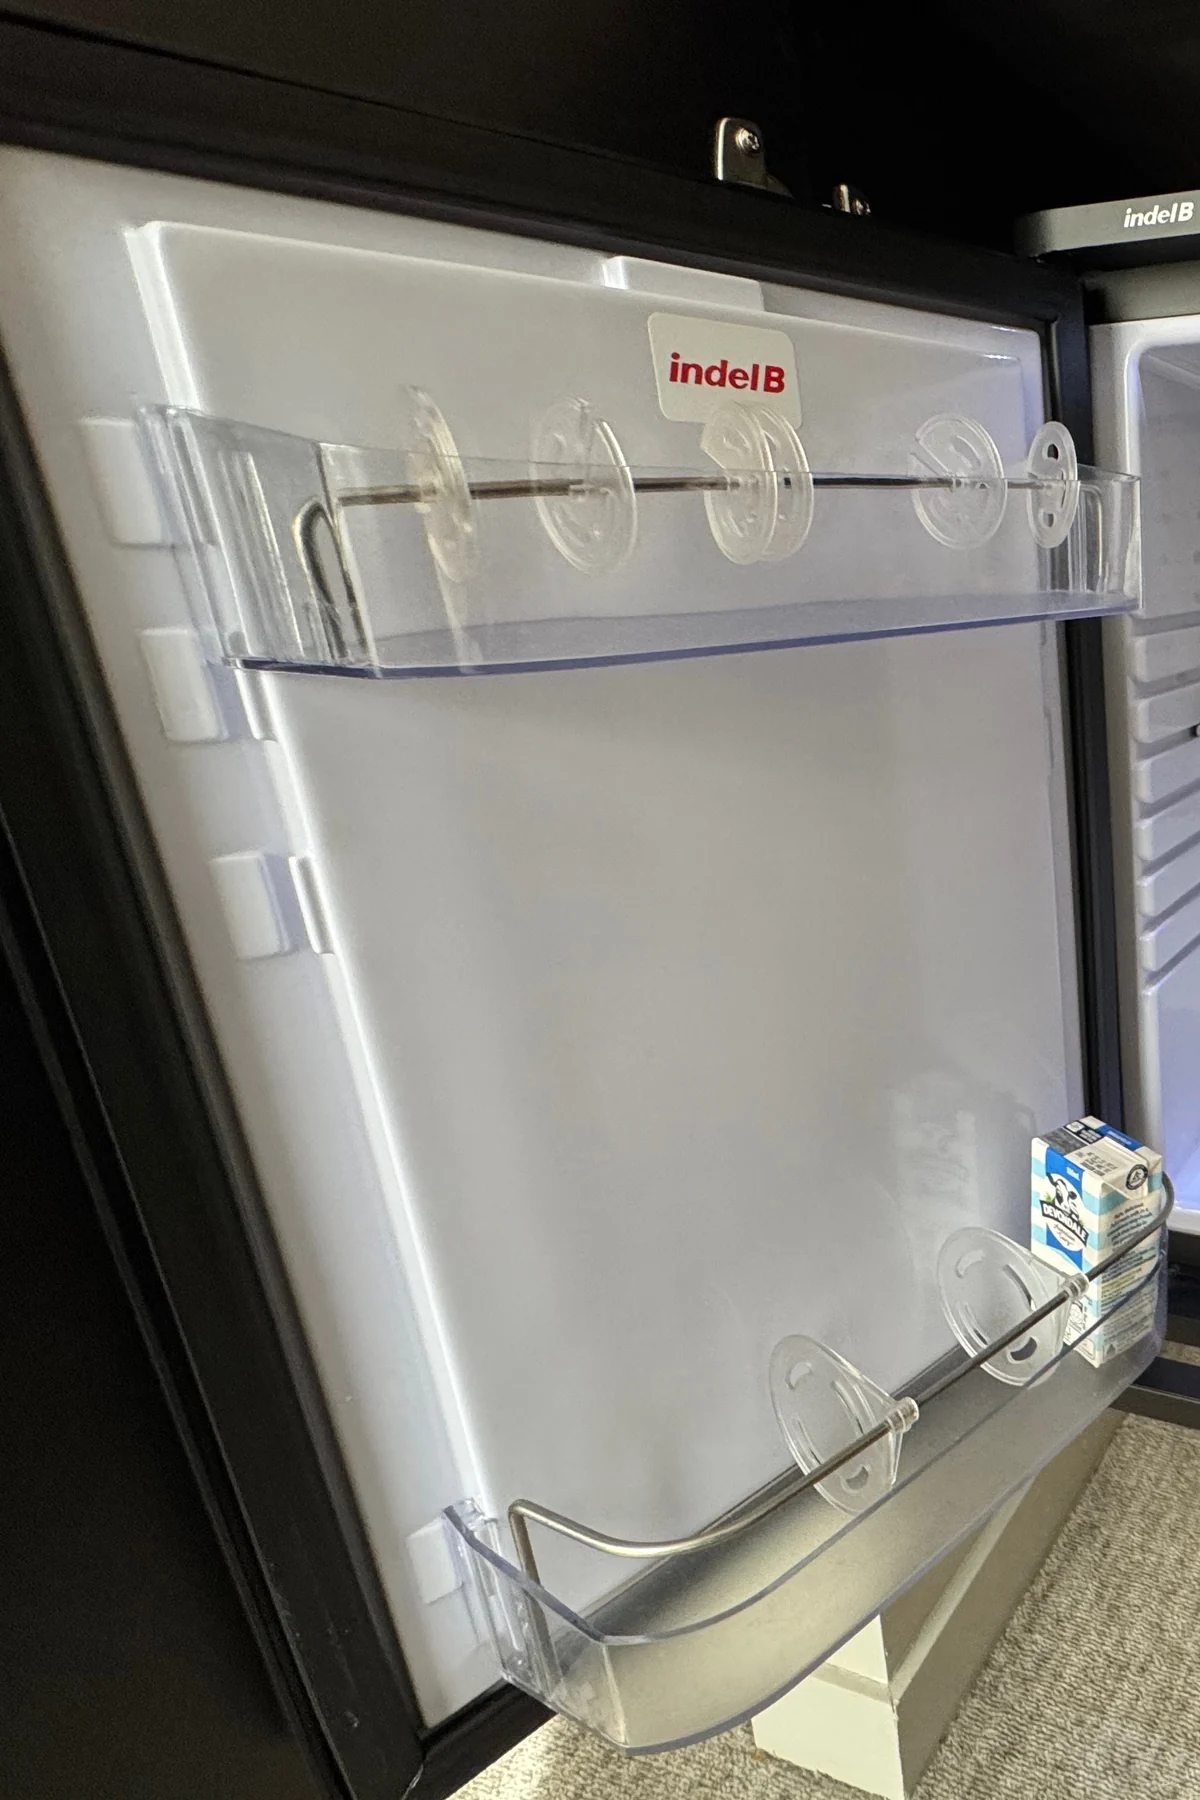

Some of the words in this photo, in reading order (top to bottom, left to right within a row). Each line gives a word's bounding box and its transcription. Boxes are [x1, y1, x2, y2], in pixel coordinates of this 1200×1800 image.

[1123, 202, 1194, 228] indelB
[669, 352, 785, 394] indelB
[1043, 1203, 1087, 1241] DEVONDALE
